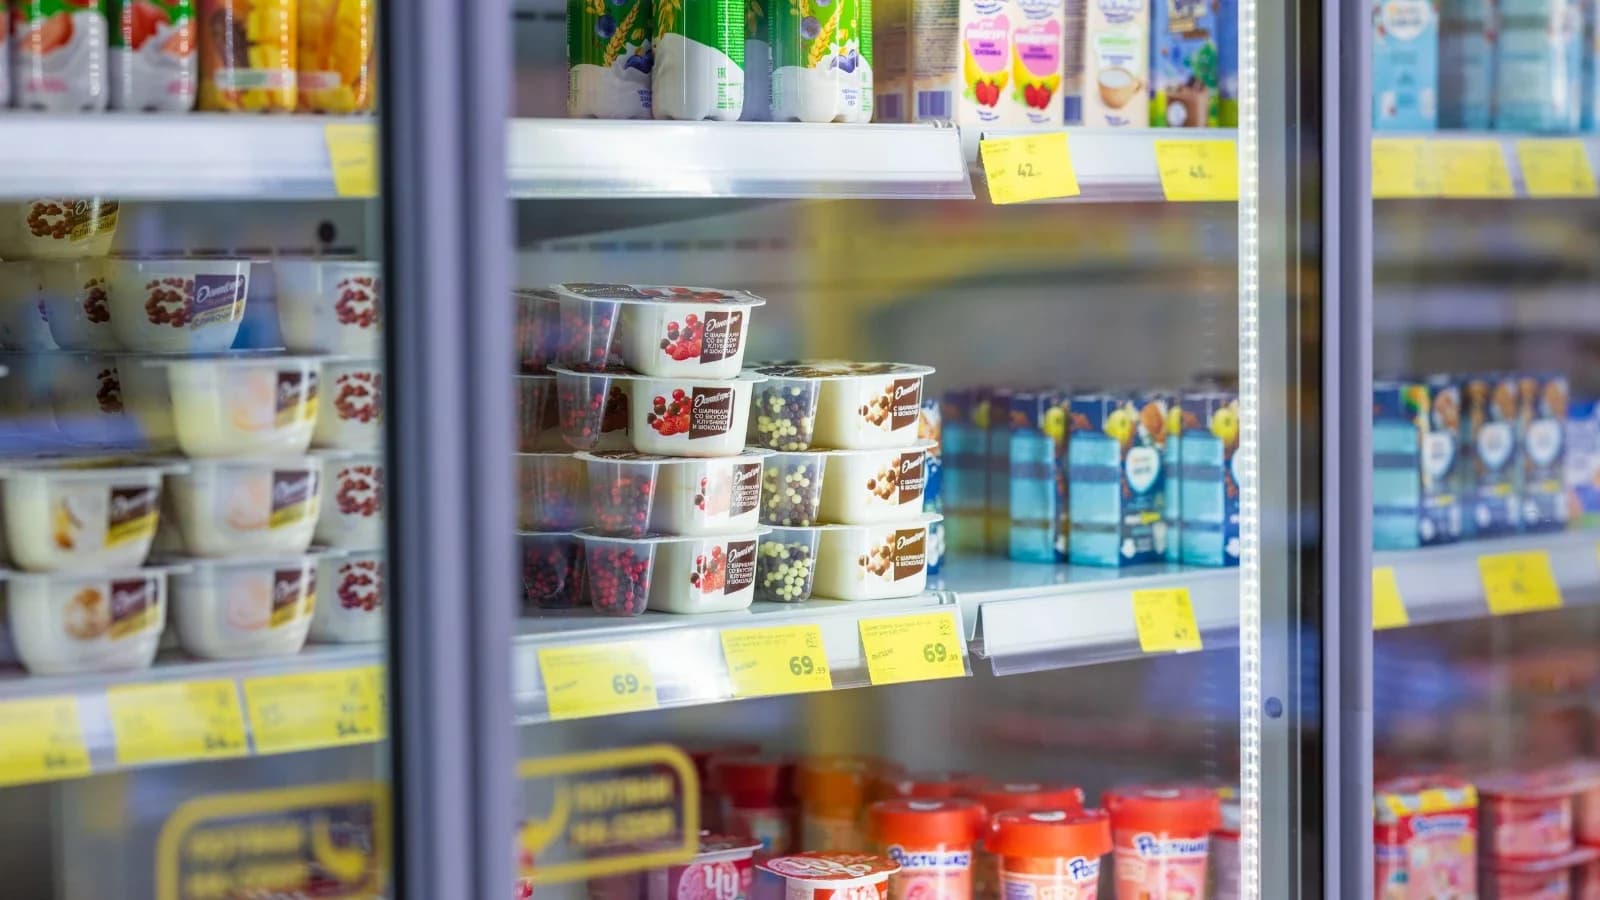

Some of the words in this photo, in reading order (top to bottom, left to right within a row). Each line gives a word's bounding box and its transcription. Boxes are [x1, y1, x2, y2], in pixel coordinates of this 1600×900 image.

[923, 642, 948, 663] 69
[789, 655, 815, 676] 69
[611, 672, 639, 695] 69
